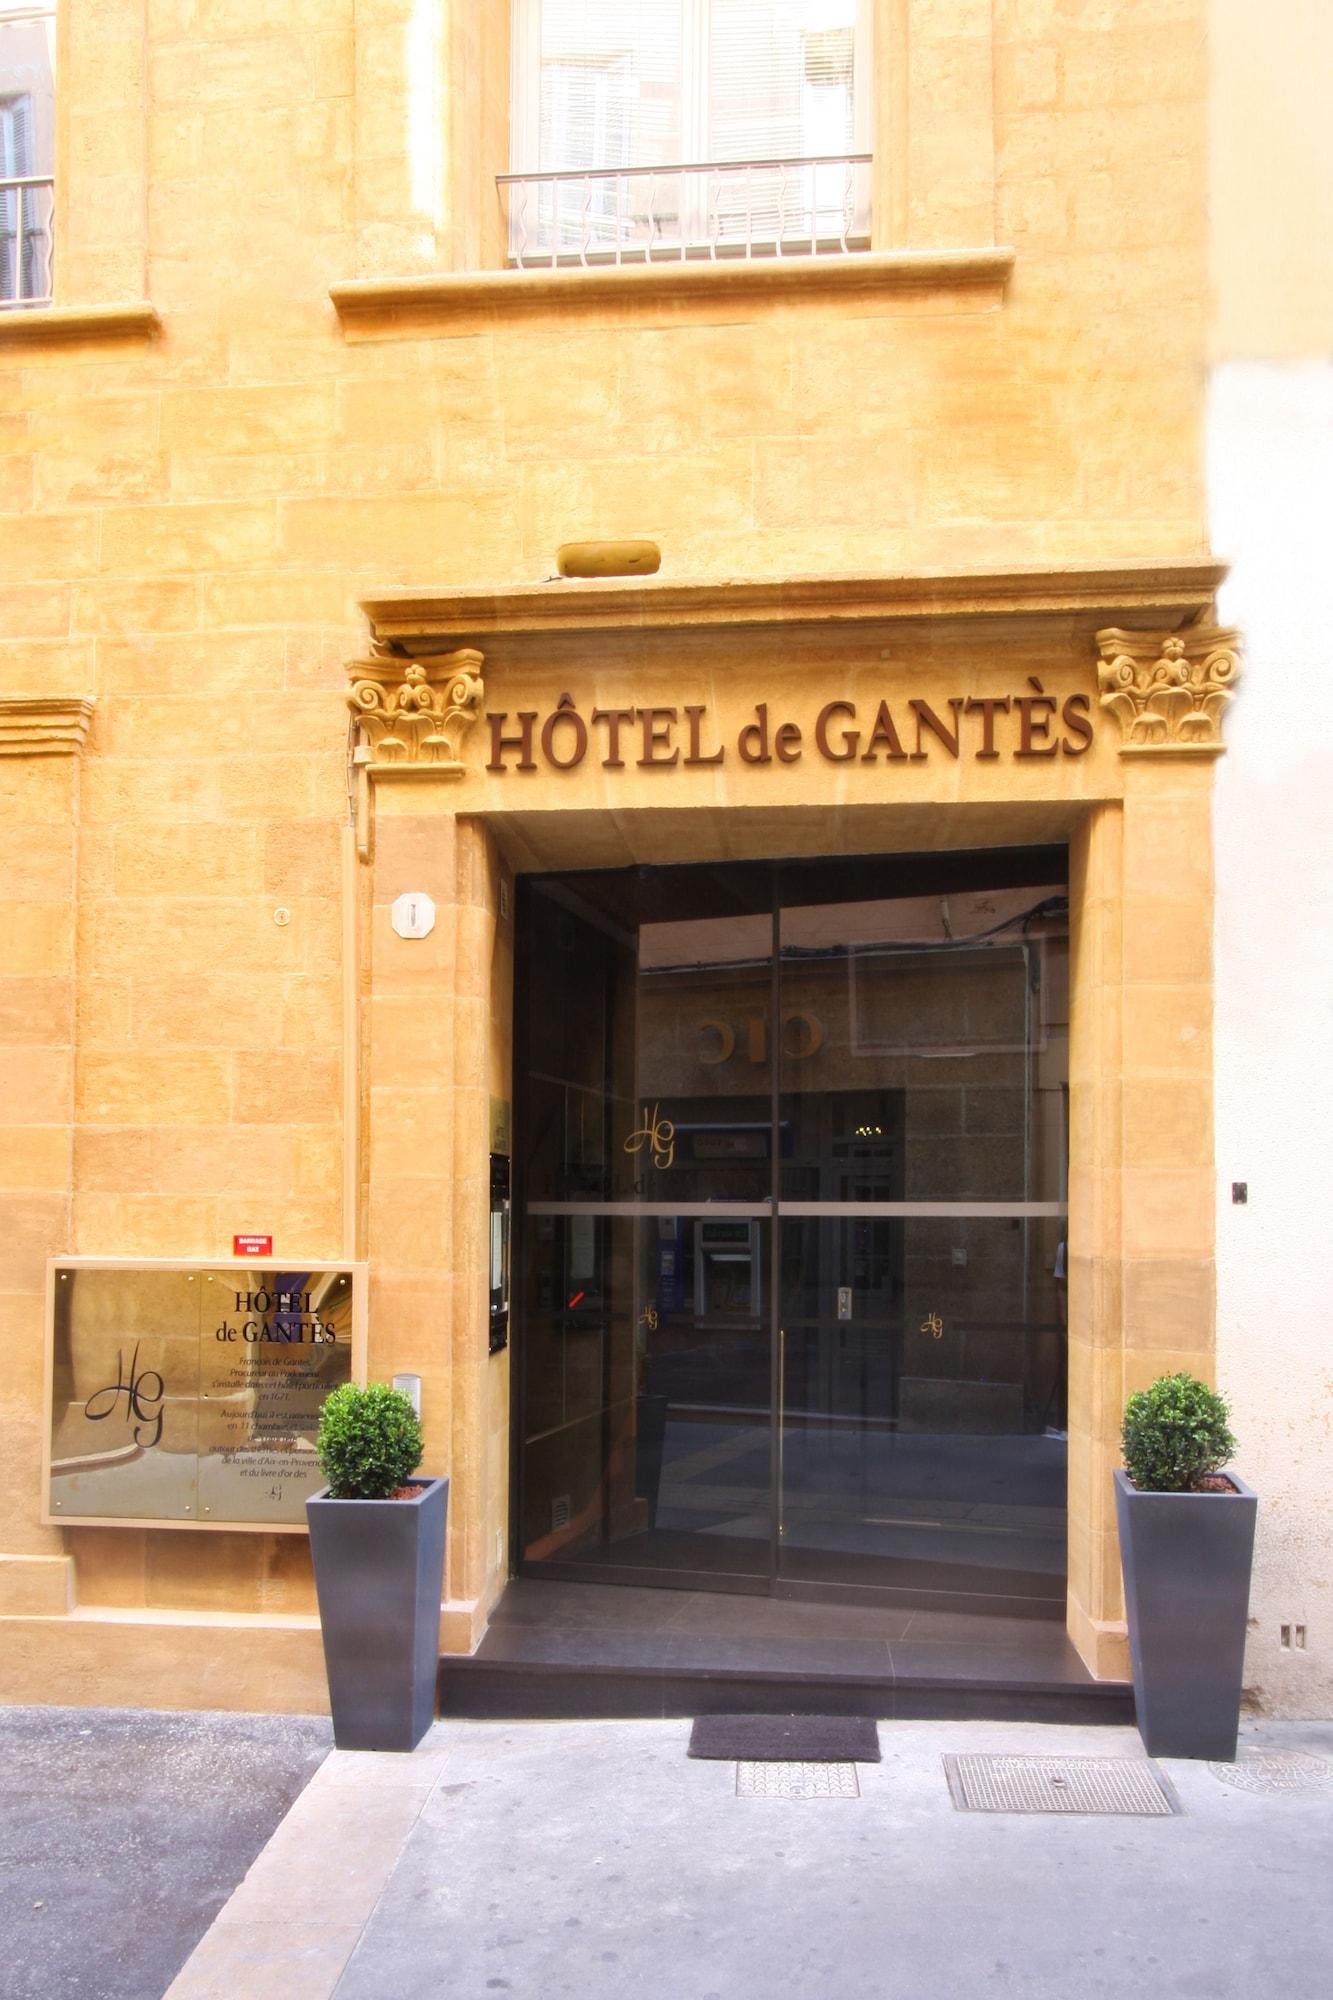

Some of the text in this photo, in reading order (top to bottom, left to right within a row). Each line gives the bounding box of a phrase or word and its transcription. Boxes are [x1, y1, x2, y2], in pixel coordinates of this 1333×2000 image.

[485, 677, 1094, 770] HÔTEL de GANTÈS
[234, 1285, 318, 1314] HÔTEL
[216, 1316, 336, 1345] de GANTÈS
